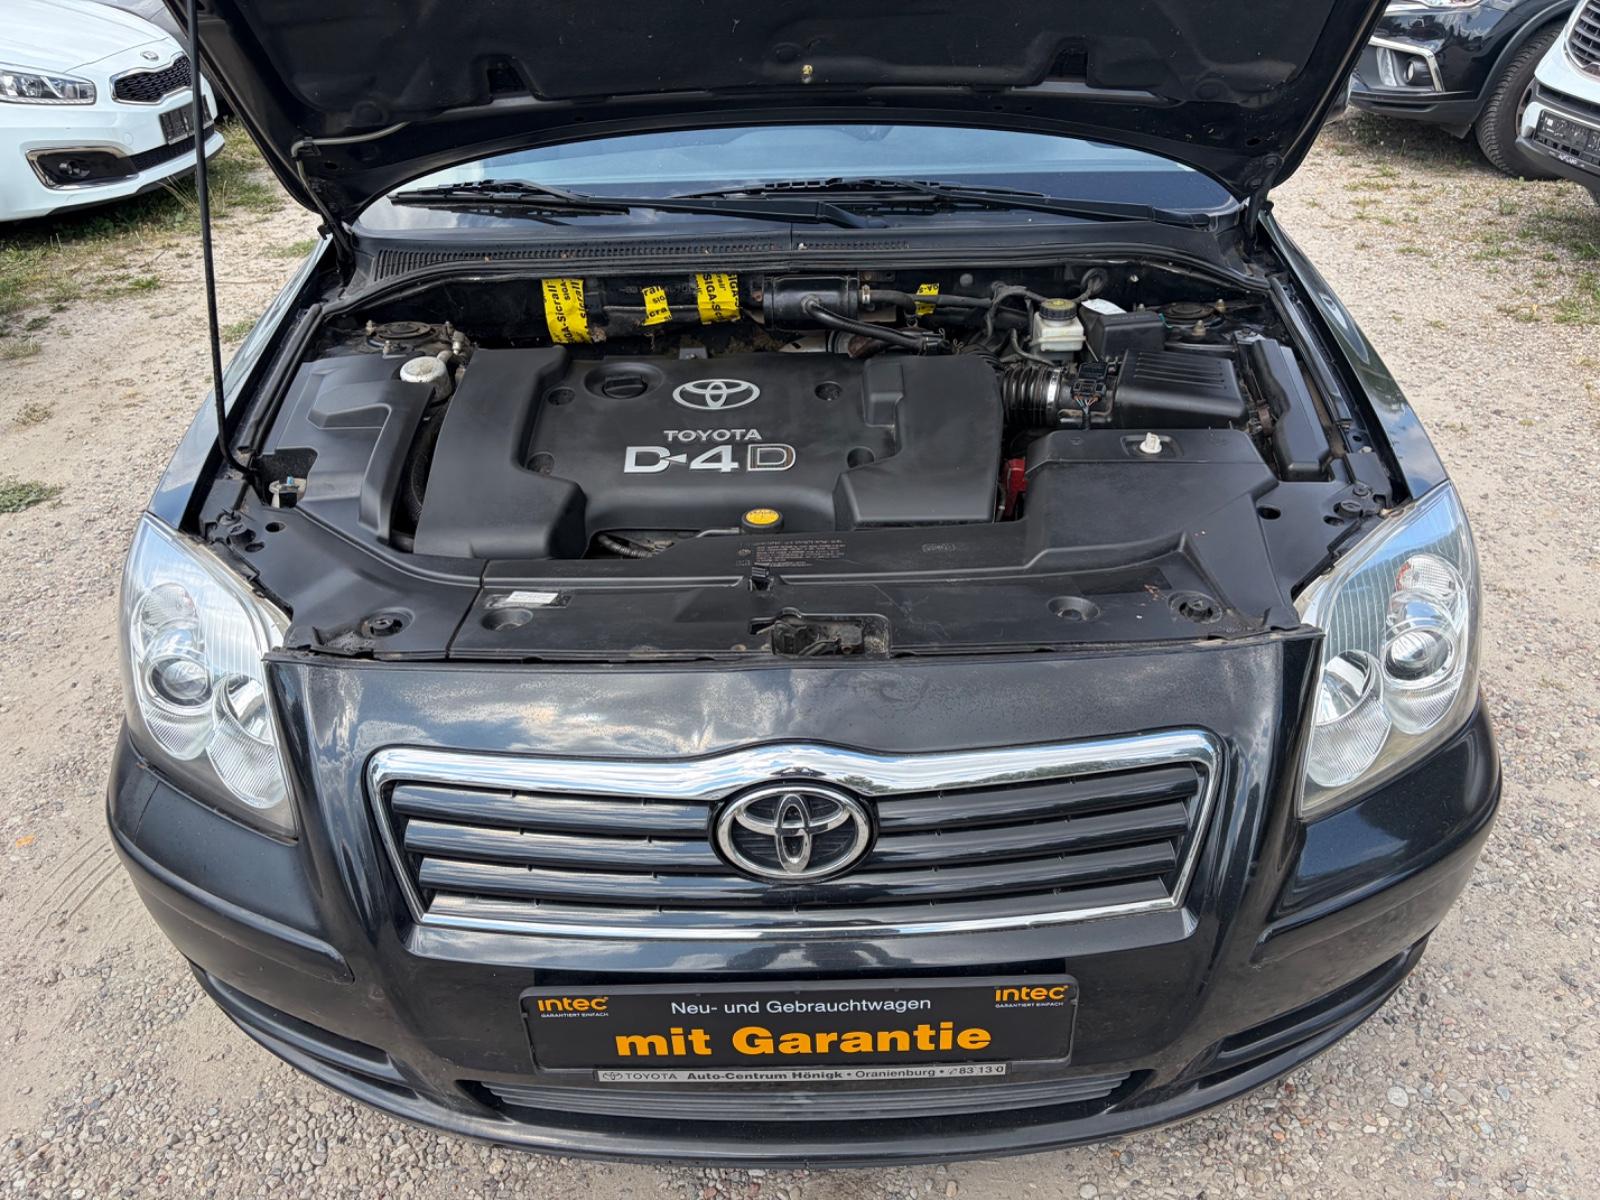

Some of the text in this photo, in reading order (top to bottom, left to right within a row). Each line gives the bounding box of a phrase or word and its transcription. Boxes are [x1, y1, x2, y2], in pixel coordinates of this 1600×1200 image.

[663, 428, 763, 442] TOYOTA
[995, 986, 1068, 1002] intec
[538, 997, 609, 1012] intec
[671, 998, 931, 1015] Neu- und Gebrauchtwagen
[615, 1021, 992, 1056] mit Garantie
[687, 1071, 788, 1080] Auto-Centrum
[792, 1071, 843, 1080] Hönigk
[855, 1068, 936, 1078] Oranienburg
[959, 1067, 974, 1075] 83
[979, 1066, 993, 1074] 13
